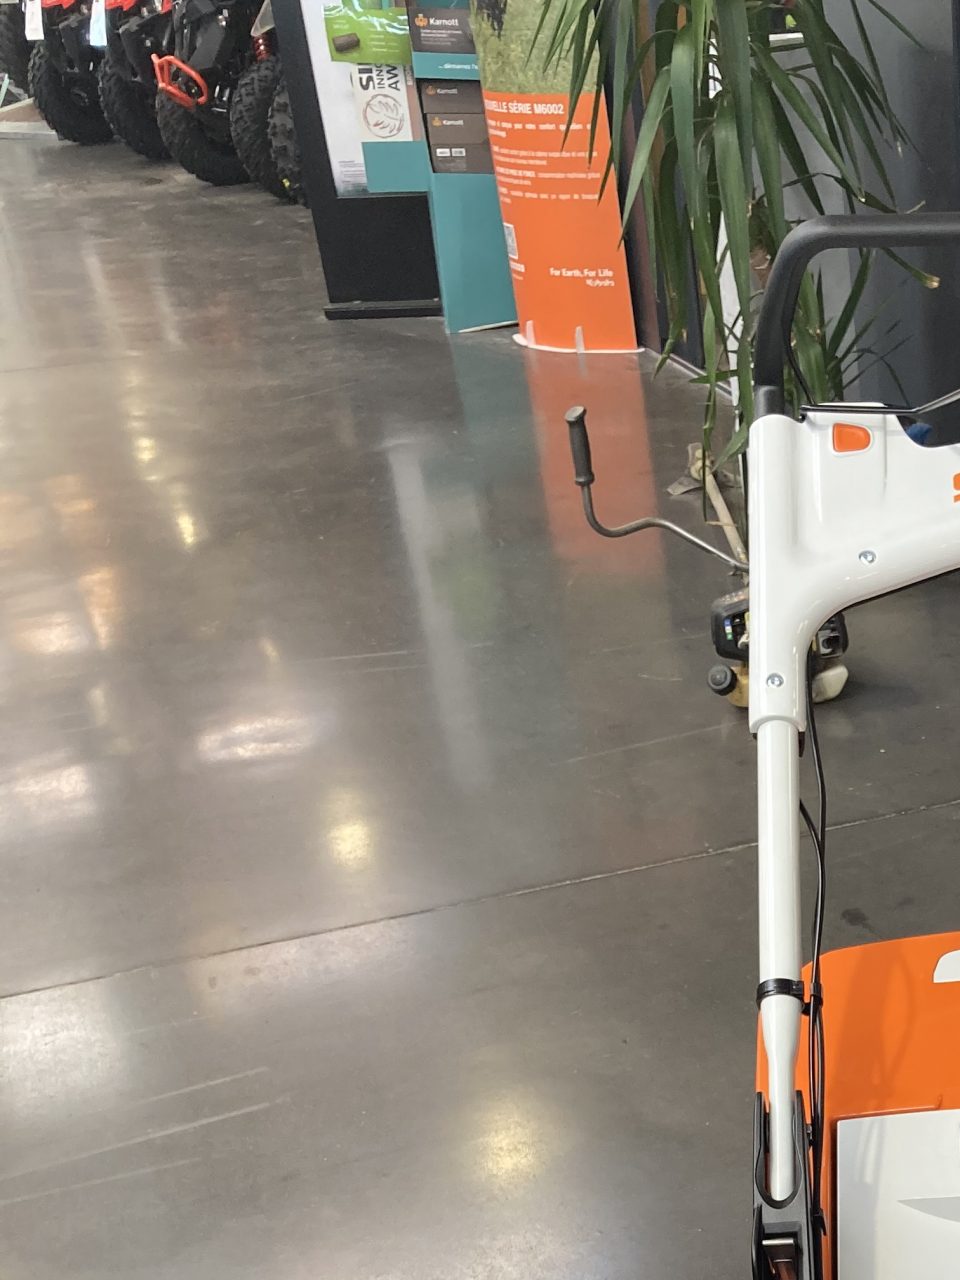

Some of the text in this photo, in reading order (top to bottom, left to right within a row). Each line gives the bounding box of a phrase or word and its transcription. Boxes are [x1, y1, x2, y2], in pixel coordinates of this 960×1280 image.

[429, 17, 459, 26] Karnott
[533, 103, 564, 115] M6002
[583, 268, 597, 277] For
[598, 268, 613, 277] Life
